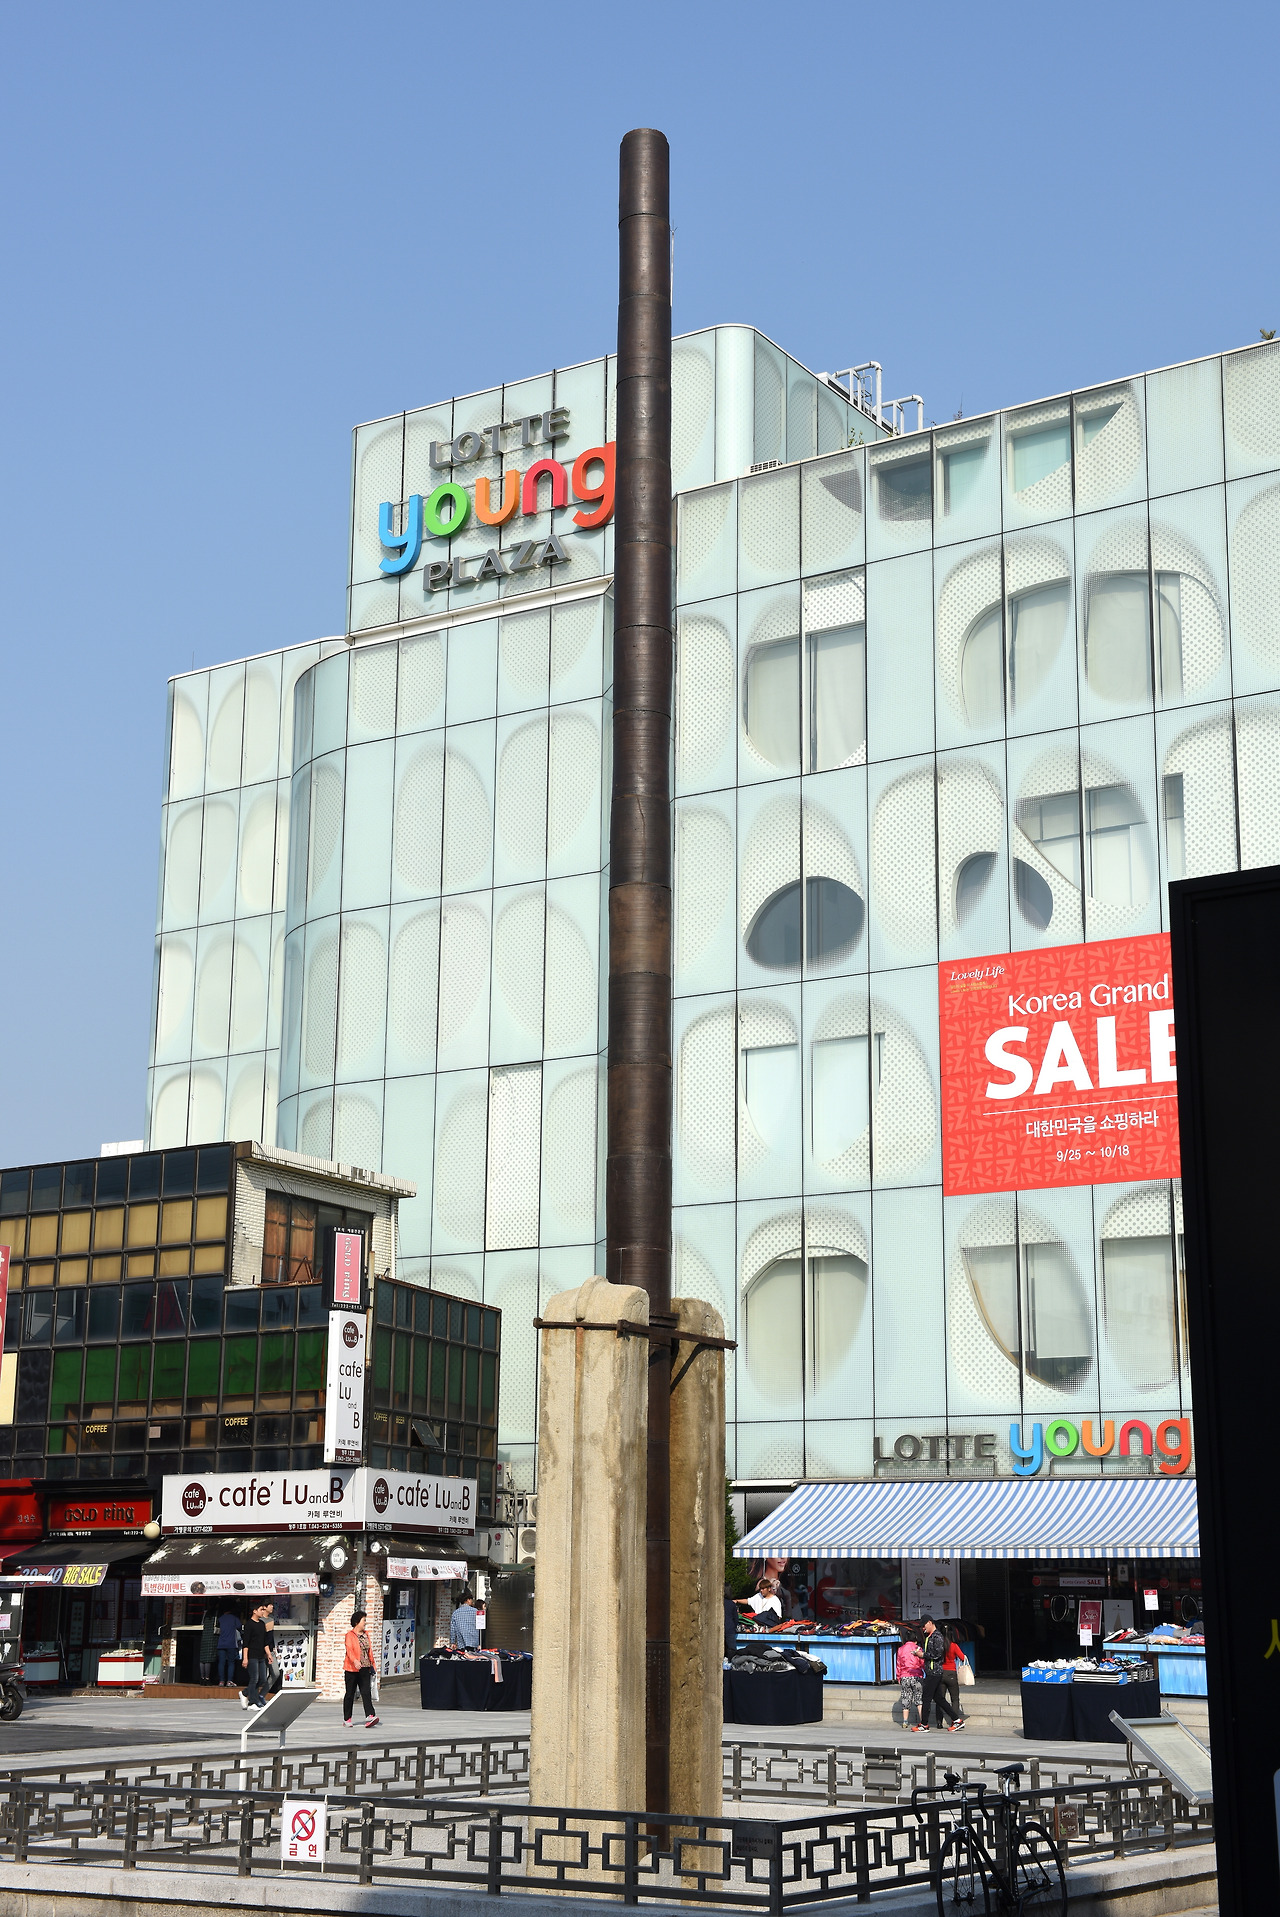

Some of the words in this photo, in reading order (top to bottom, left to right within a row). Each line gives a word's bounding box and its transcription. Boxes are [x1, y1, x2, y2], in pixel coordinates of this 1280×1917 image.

[429, 406, 570, 470] LOTTE
[379, 441, 617, 575] young
[423, 534, 571, 593] PLAZA
[950, 969, 984, 981] Lovely
[985, 965, 1005, 978] Life
[1008, 991, 1082, 1017] Korea
[1090, 973, 1169, 1007] Grand
[984, 1008, 1178, 1100] SALE
[1026, 1115, 1097, 1138] 대한민국을
[1101, 1110, 1159, 1132] 쇼핑하라
[1056, 1148, 1082, 1162] 9/25
[1100, 1145, 1130, 1158] 10/18
[339, 1382, 352, 1400] Lu
[85, 1424, 107, 1434] COFFEE
[224, 1417, 248, 1427] COFFEE
[353, 1412, 360, 1429] B
[873, 1433, 997, 1461] LOTTE
[1009, 1418, 1192, 1476] young
[64, 1507, 98, 1522] GOLD
[104, 1502, 135, 1523] ring
[307, 1510, 321, 1519] 카페
[322, 1510, 343, 1518] 루앤비
[62, 1566, 81, 1584] BIG
[78, 1566, 103, 1584] SALE
